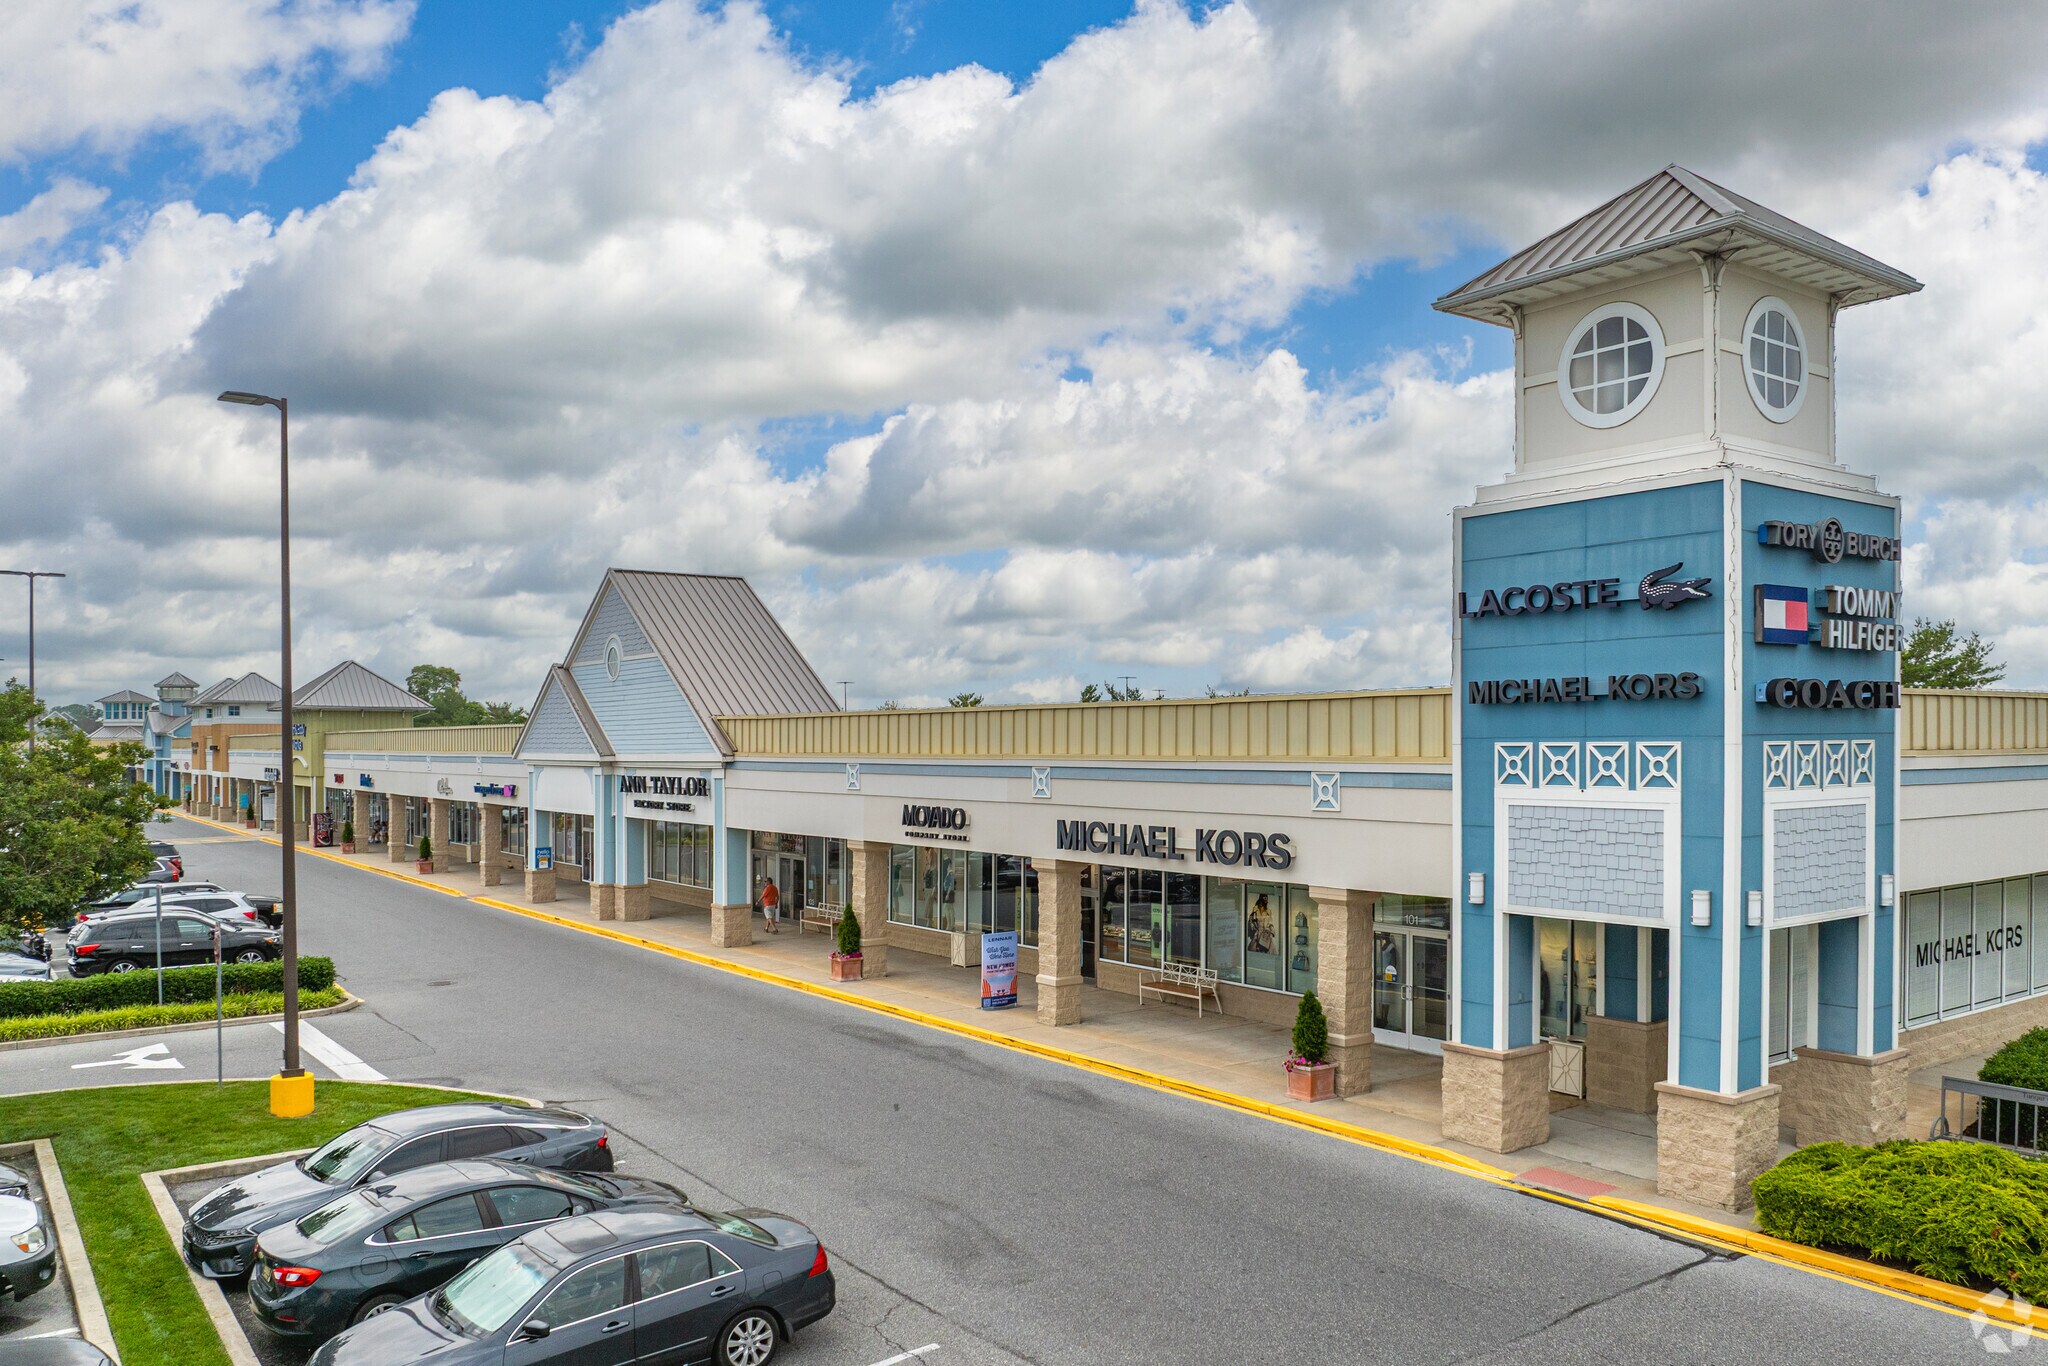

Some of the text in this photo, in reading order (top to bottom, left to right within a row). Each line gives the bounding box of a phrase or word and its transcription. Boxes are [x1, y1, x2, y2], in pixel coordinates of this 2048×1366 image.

[1767, 521, 1901, 560] TORY BURCH
[1459, 578, 1621, 618] LACOSTE
[1832, 585, 1902, 618] TOMMY
[1826, 619, 1904, 651] HILFIGER
[1469, 672, 1702, 704] MICHAEL KORS
[1768, 678, 1901, 709] COACH
[620, 775, 708, 796] ANN TAYLOR
[666, 802, 692, 812] STORE
[902, 804, 966, 830] MOVADO
[905, 831, 939, 840] COMPANY
[1057, 819, 1291, 870] MICHAEL KORS
[1405, 914, 1419, 925] 101
[1916, 934, 1981, 967] MICHAEL
